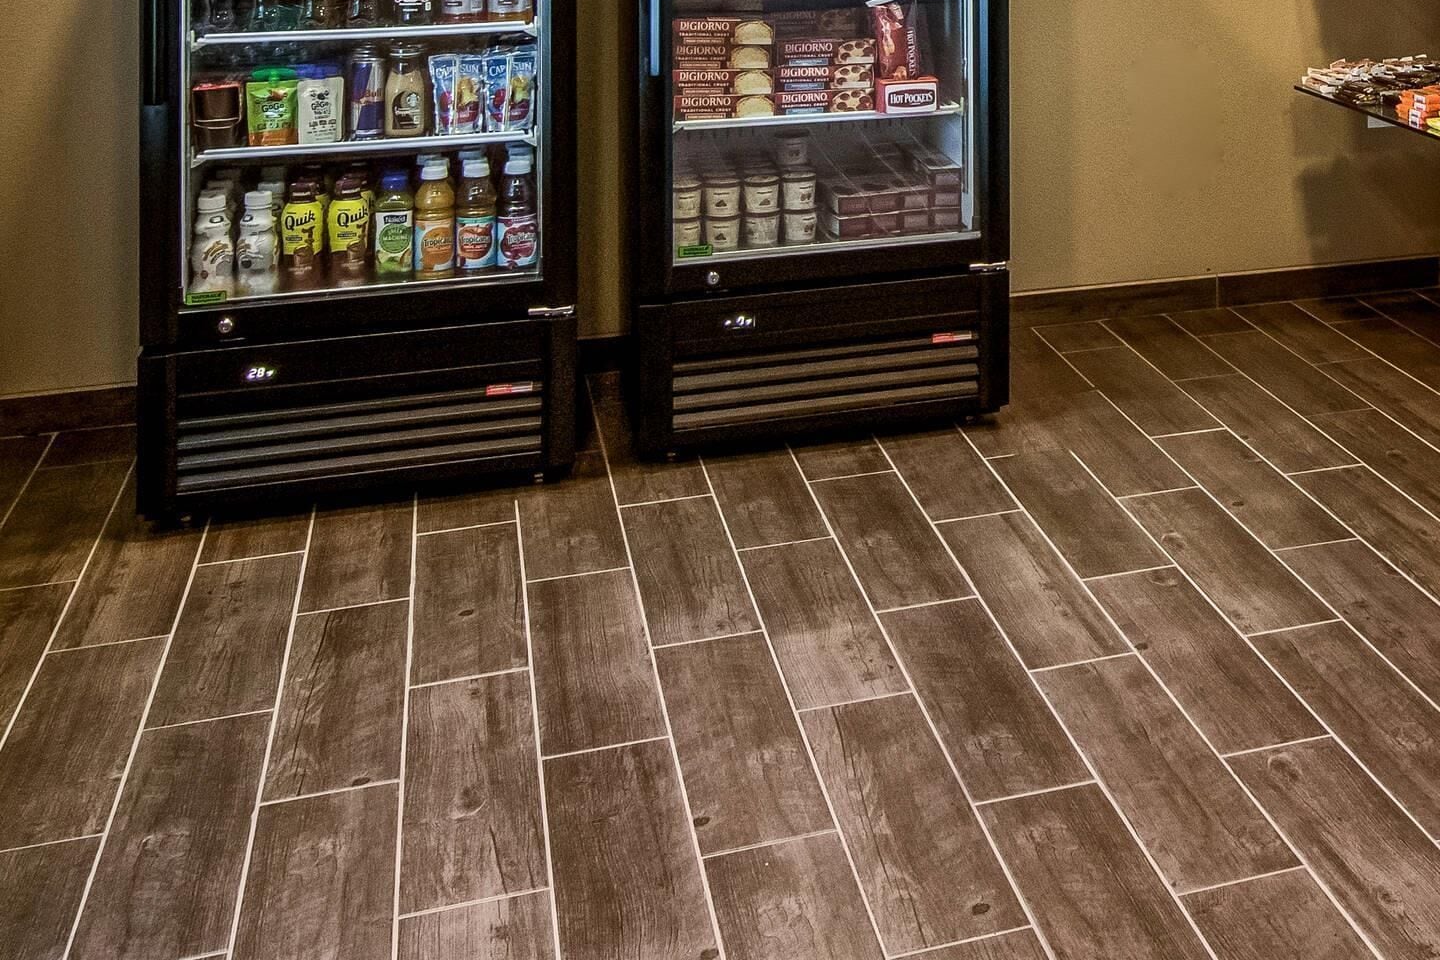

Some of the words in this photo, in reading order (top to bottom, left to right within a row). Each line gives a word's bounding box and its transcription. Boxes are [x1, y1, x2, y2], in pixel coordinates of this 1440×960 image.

[679, 21, 730, 31] DIGIORNO
[676, 45, 726, 55] DIGIORNO
[784, 42, 833, 53] DIGIORNO
[679, 71, 730, 81] DIGIORNO
[781, 67, 830, 78] DIGIORNO
[681, 96, 731, 107] DIGIORNO
[782, 92, 828, 104] DIGIORNO
[890, 94, 904, 105] HOT
[905, 92, 933, 104] POCKETS
[284, 210, 316, 231] Quik
[337, 206, 369, 228] Quik
